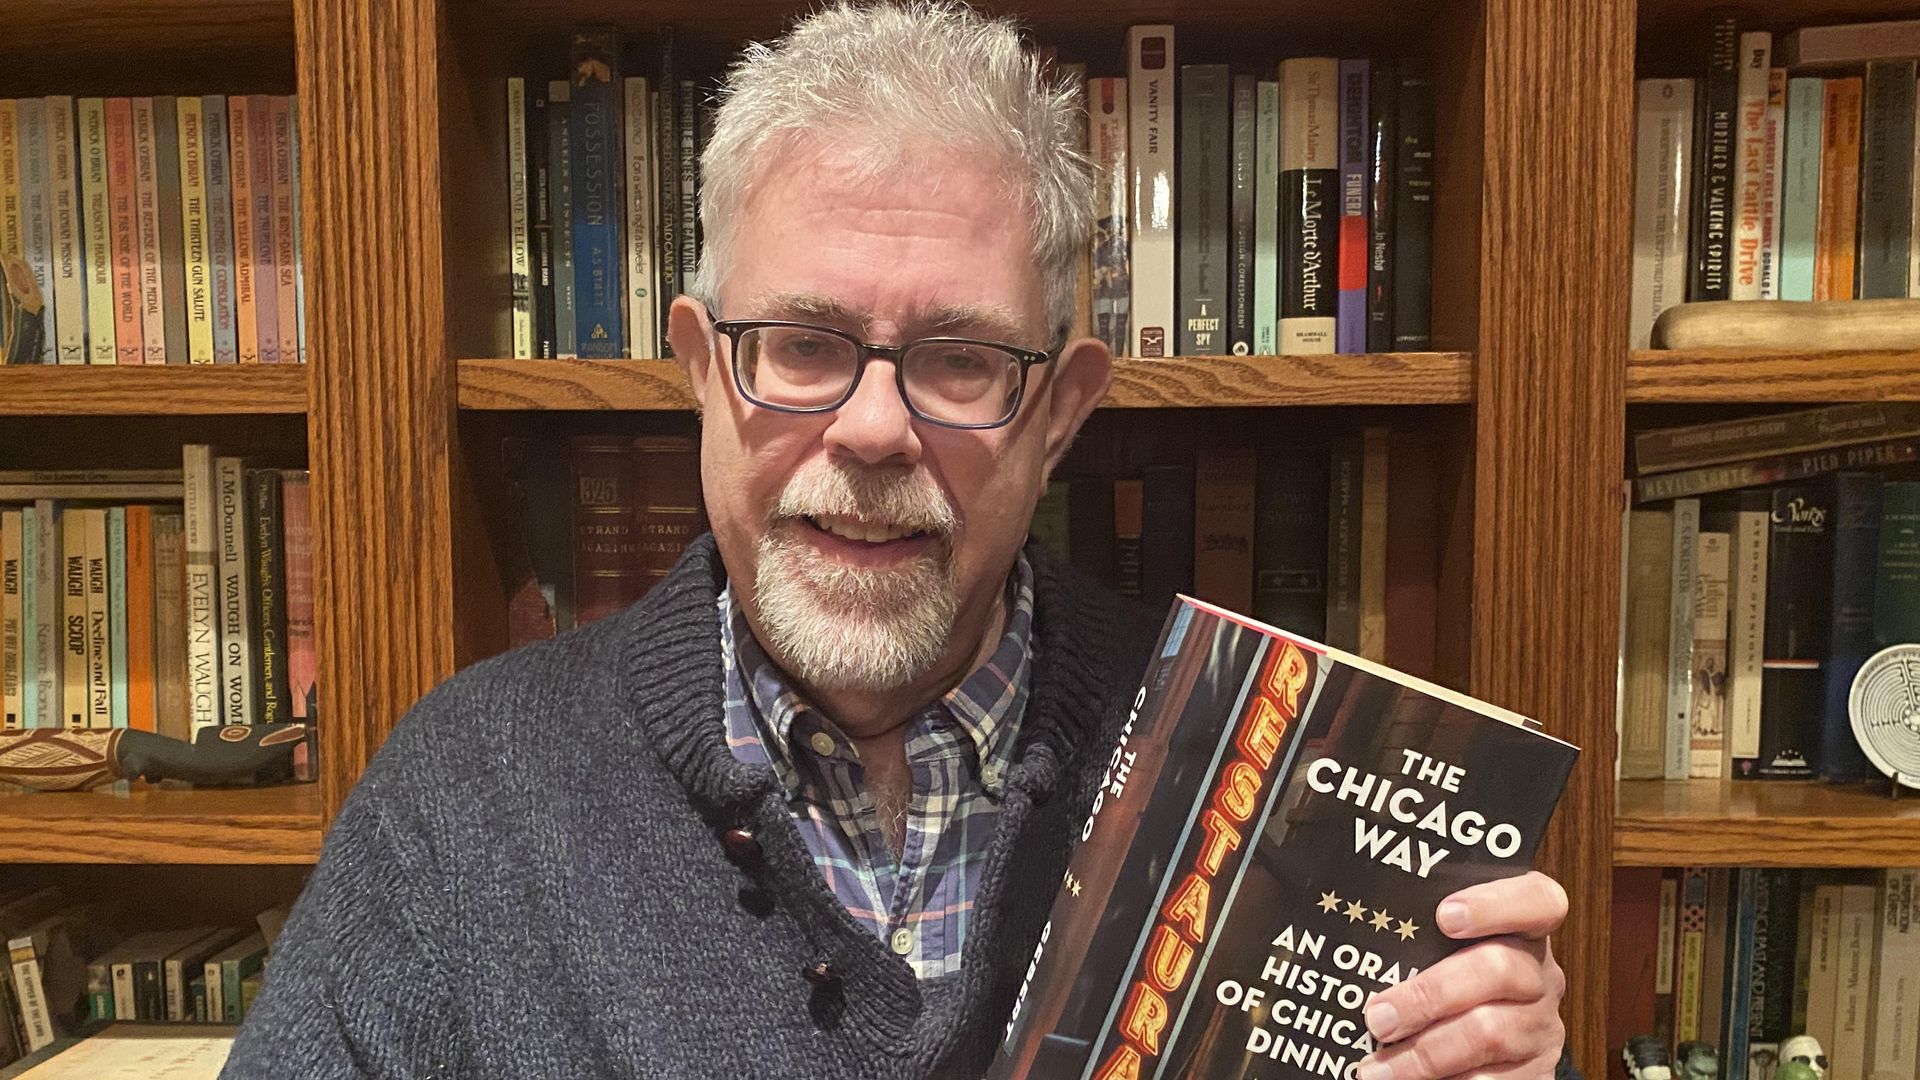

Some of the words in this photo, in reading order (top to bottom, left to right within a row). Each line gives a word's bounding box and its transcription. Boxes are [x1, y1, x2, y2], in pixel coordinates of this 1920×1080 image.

[1148, 80, 1158, 124] VANITY
[1746, 99, 1764, 132] The
[185, 113, 197, 148] PATRICK
[1148, 128, 1158, 154] FAIR
[1712, 112, 1728, 170] MURTHER
[582, 102, 603, 226] POSSESSION
[1744, 138, 1763, 173] Last
[5, 195, 16, 212] THE
[31, 194, 42, 212] THE
[58, 190, 70, 207] THE
[117, 196, 129, 214] THE
[142, 192, 153, 210] THE
[189, 197, 200, 216] THE
[213, 197, 225, 215] THE
[258, 195, 269, 213] THE
[278, 195, 290, 214] THE
[513, 171, 524, 215] CROME
[1303, 179, 1322, 198] Le
[1741, 179, 1760, 230] Cattle
[94, 192, 106, 241] TREASON'S
[118, 216, 130, 232] FAR
[237, 198, 247, 217] THE
[682, 193, 695, 223] ITALO
[1302, 200, 1322, 248] Morte
[1709, 187, 1725, 240] WALKING
[120, 233, 131, 256] SIDE
[143, 211, 155, 251] REVERSE
[190, 218, 203, 263] THIRTEEN
[238, 219, 250, 259] YELLOW
[259, 214, 272, 266] TRUELOVE
[515, 219, 526, 266] YELLOW
[1375, 232, 1384, 242] Jo
[61, 242, 74, 279] MISSION
[95, 243, 107, 285] HARBOUR
[121, 257, 133, 271] OF
[145, 252, 156, 267] OF
[682, 228, 696, 273] CALVINO
[1373, 243, 1385, 272] Nesbø
[1706, 245, 1724, 290] SPIRITS
[1739, 238, 1758, 286] Drive
[122, 272, 133, 289] THE
[146, 268, 157, 284] THE
[192, 266, 204, 285] GUN
[240, 262, 252, 305] ADMIRAL
[281, 268, 293, 287] SEA
[1302, 251, 1323, 310] d'Arthur
[123, 291, 135, 323] WORLD
[147, 286, 159, 316] MEDAL
[194, 287, 206, 322] SALUTE
[217, 268, 229, 330] CONSOLATION
[1237, 263, 1246, 329] CORRESPONDENT
[1187, 319, 1219, 331] PERFECT
[1196, 334, 1212, 346] SPY
[1802, 453, 1838, 474] PIED
[1847, 444, 1896, 466] PIPER
[4, 559, 17, 595] WAUGH
[68, 555, 83, 597] WAUGH
[89, 558, 104, 594] WAUGH
[193, 572, 210, 643] EVELYN
[227, 574, 241, 635] WAUGH
[259, 516, 270, 548] Evelyn
[265, 681, 276, 699] and
[69, 615, 84, 655] SCOOP
[91, 610, 104, 661] Decline
[228, 642, 242, 666] ON
[93, 662, 107, 686] and
[195, 652, 213, 723] WAUGH
[95, 689, 107, 715] Fall
[1081, 686, 1146, 842] CHICAGO
[1110, 751, 1137, 799] THE
[1401, 749, 1466, 794] THE
[1306, 757, 1522, 858] CHICAGO
[1355, 817, 1450, 879] WAY
[1272, 925, 1326, 960] AN
[1006, 921, 1051, 1041] GEBERT
[1261, 956, 1379, 1014] HISTO
[1216, 980, 1265, 1012] OF
[1271, 999, 1374, 1053] CHICA
